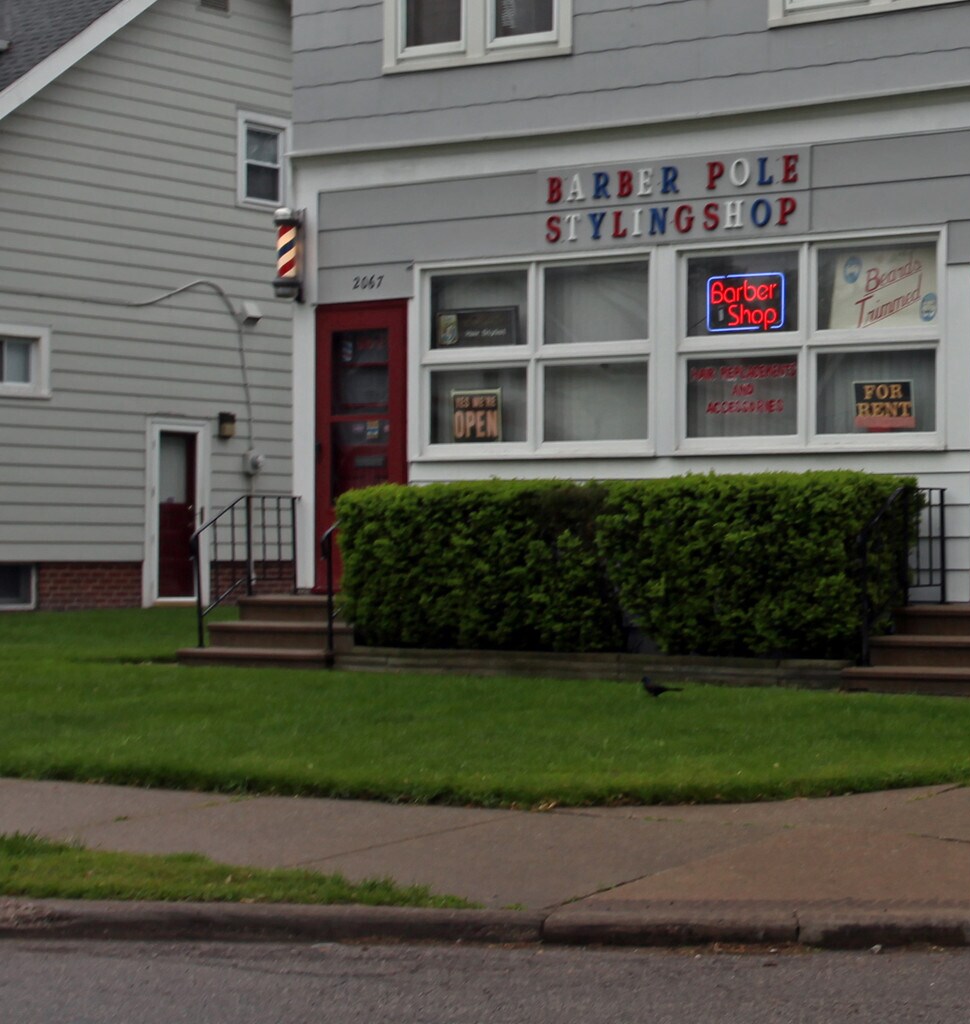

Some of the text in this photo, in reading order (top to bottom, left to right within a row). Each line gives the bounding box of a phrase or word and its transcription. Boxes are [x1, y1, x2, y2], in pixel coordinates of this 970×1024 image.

[547, 153, 799, 204] BARBER POLE
[352, 274, 384, 290] 2067
[864, 257, 923, 293] Beards
[711, 279, 777, 304] Barber
[855, 272, 923, 329] Trimmed
[728, 304, 777, 330] Shop
[732, 382, 755, 396] AND
[863, 384, 903, 400] FOR
[706, 399, 785, 415] ACCESSORIES
[856, 401, 912, 417] RENT
[454, 410, 498, 438] OPEN
